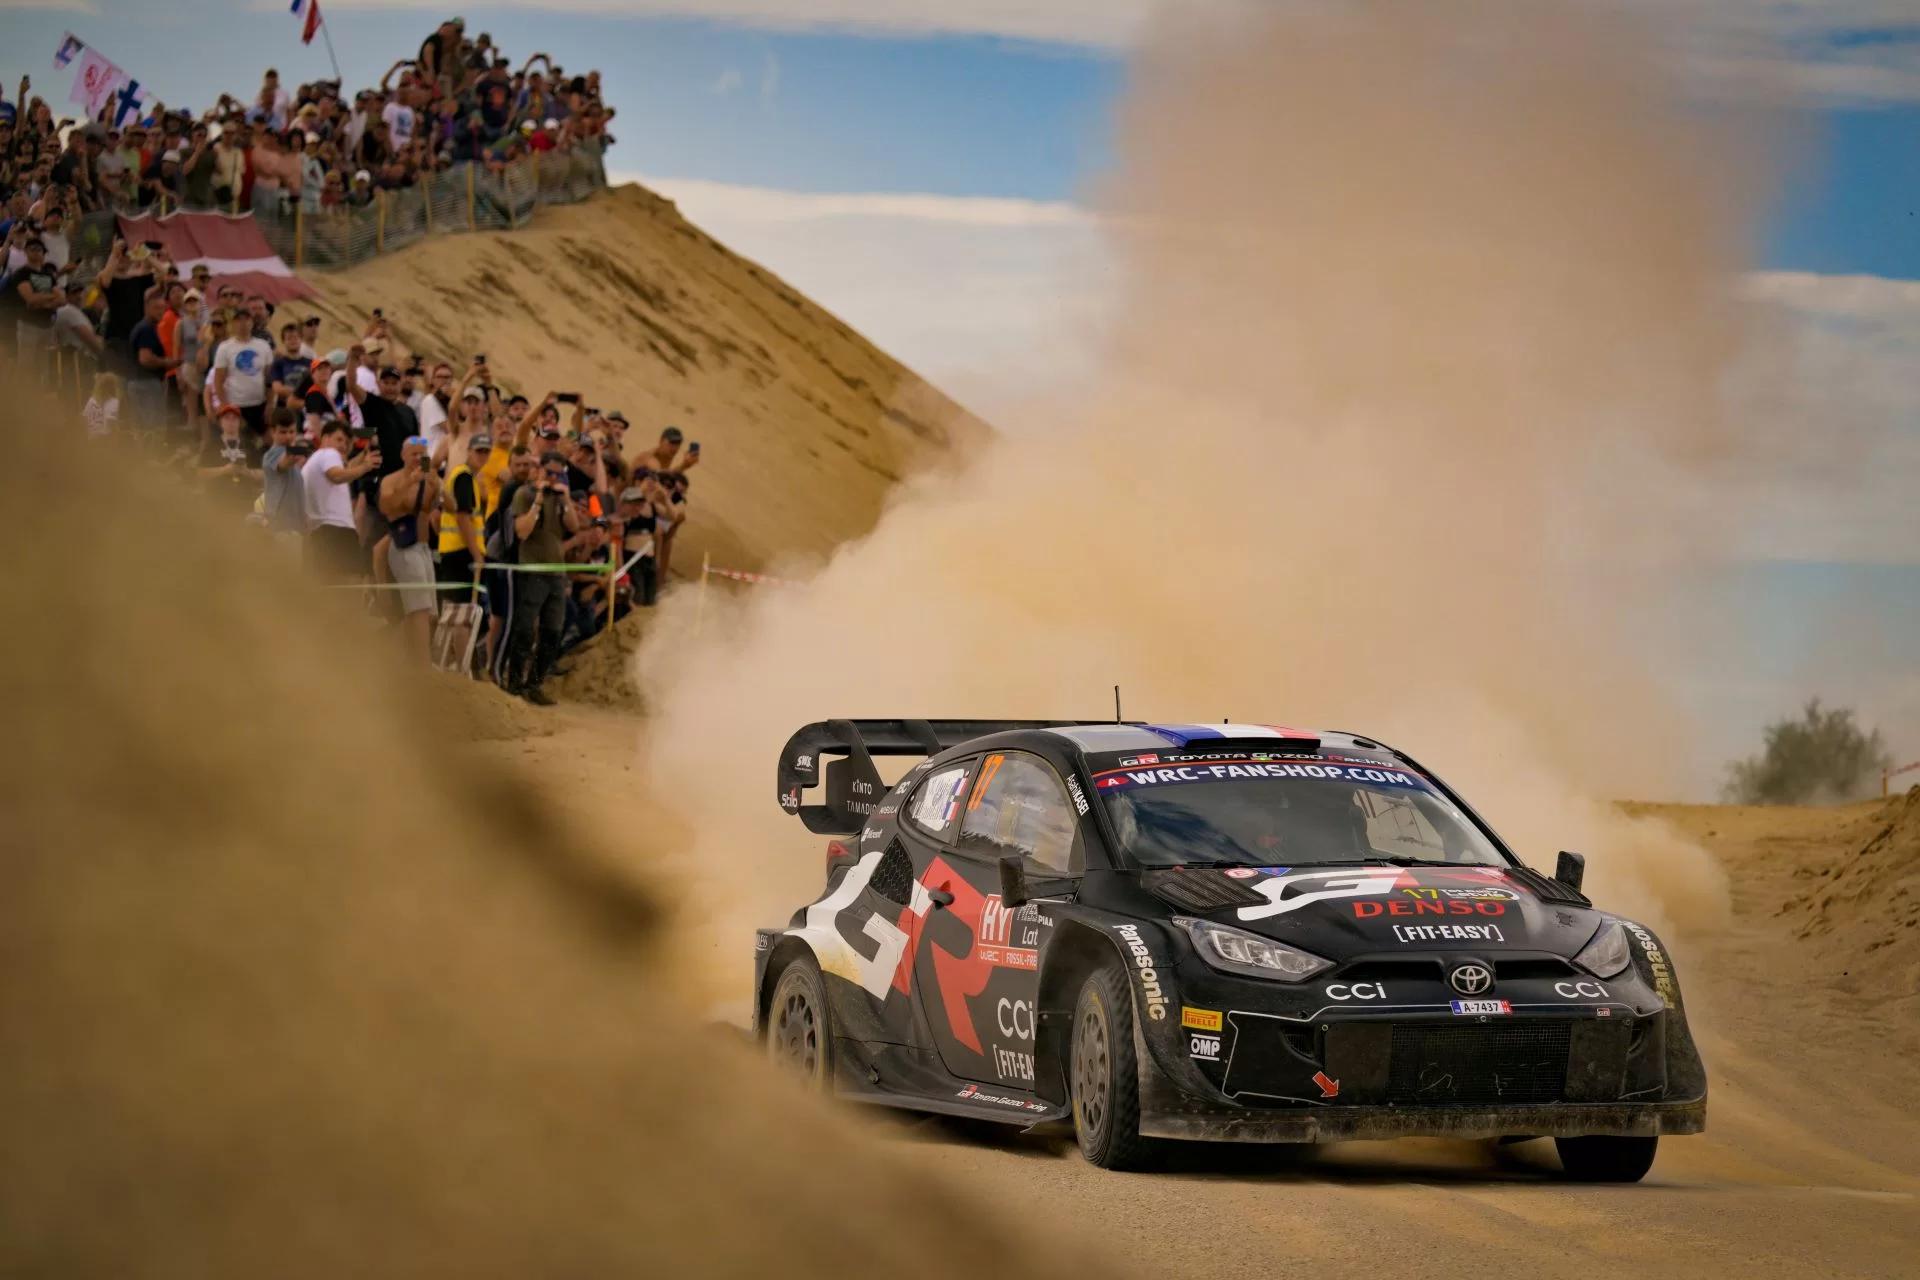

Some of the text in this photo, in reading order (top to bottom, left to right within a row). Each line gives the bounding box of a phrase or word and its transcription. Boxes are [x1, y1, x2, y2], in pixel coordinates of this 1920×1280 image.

[1126, 764, 1414, 786] WRC-FANSHOP.COM
[1352, 899, 1506, 919] DENSO
[1464, 1002, 1498, 1013] A-7437
[1184, 1010, 1218, 1028] PIRELLI
[1190, 1037, 1221, 1057] OMP
[992, 1043, 1035, 1081] [FIT-EA
